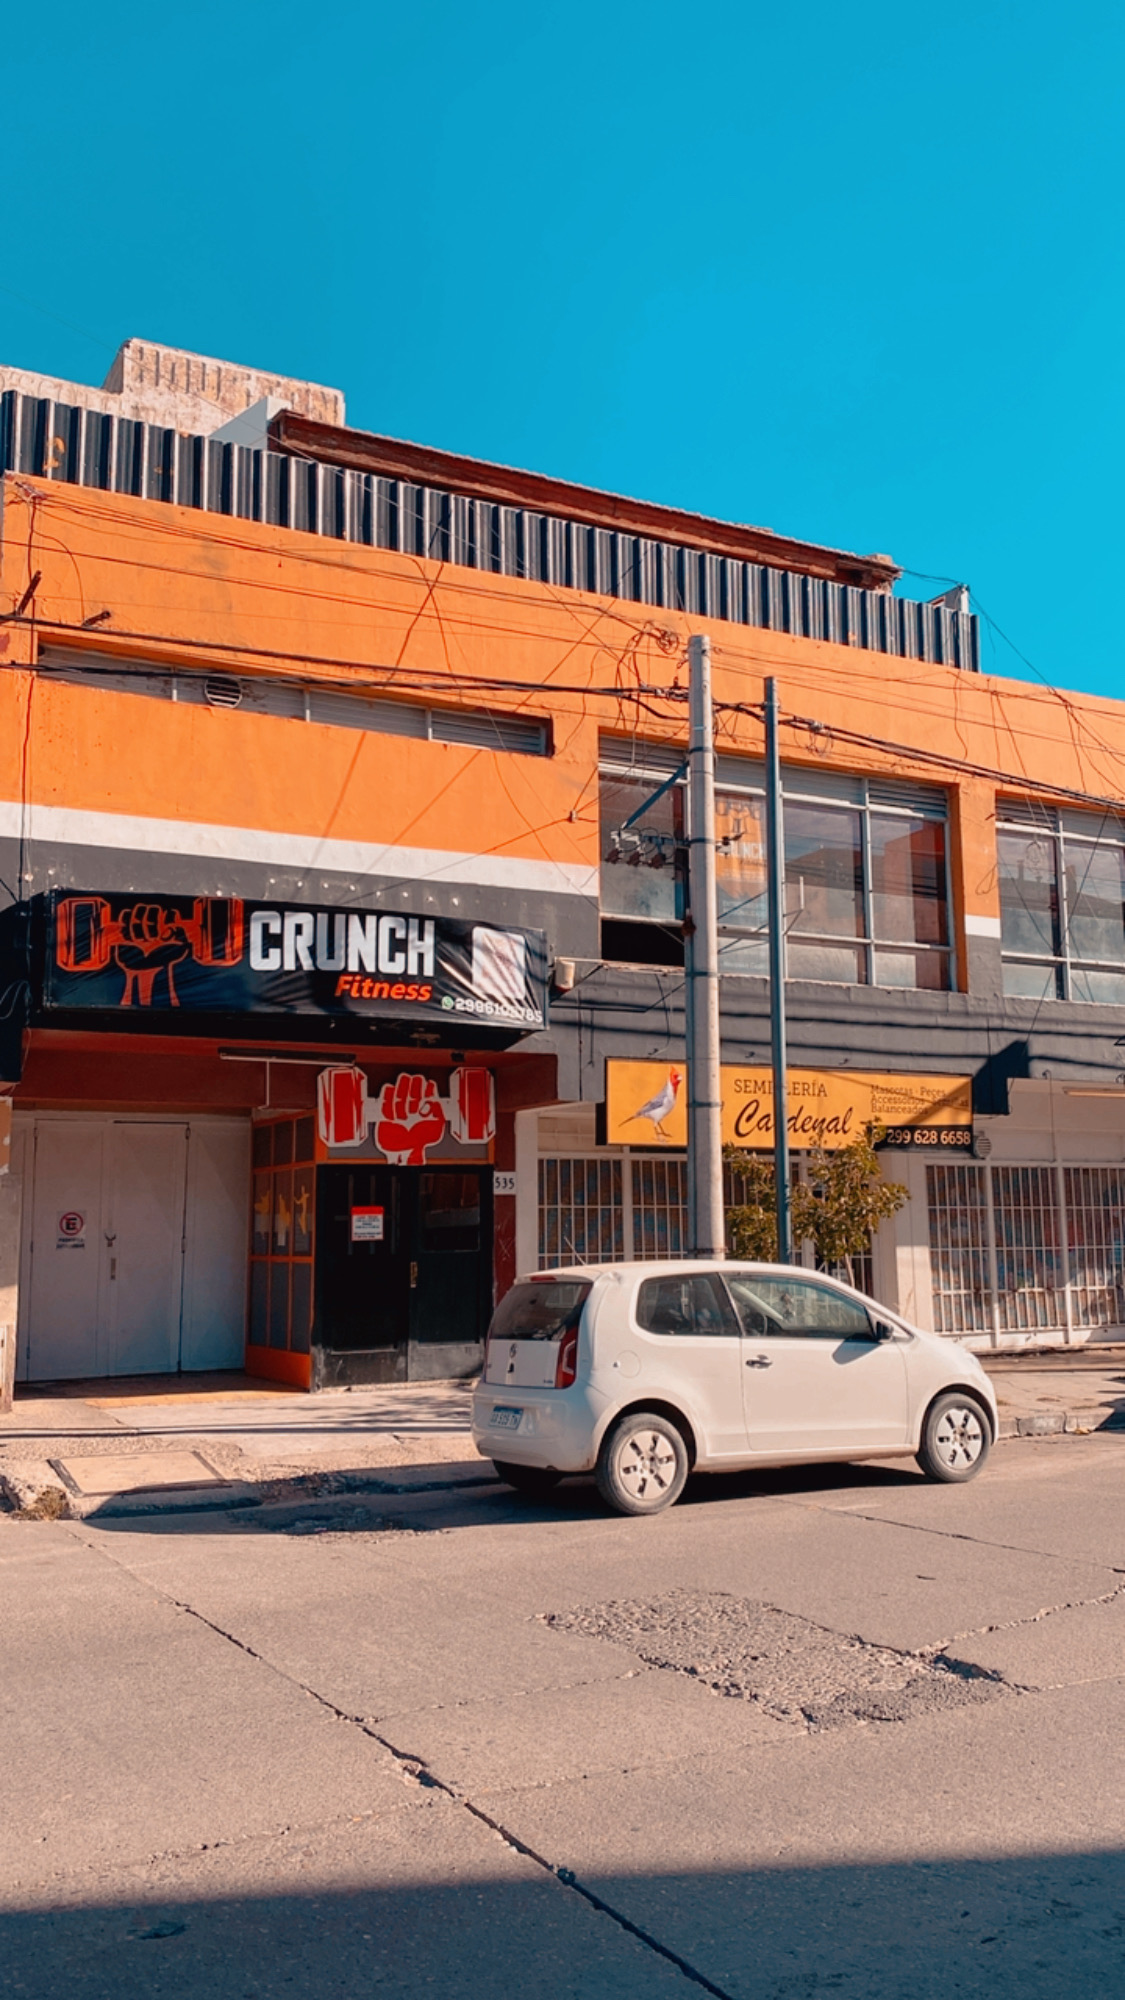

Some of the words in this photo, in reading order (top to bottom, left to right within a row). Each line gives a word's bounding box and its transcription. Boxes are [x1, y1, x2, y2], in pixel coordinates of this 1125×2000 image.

[250, 910, 435, 977] CRUNCH
[334, 974, 432, 1002] Fitness
[734, 1079, 827, 1097] SEMIERÍA
[734, 1099, 853, 1138] Cadenal
[887, 1129, 911, 1144] 299
[913, 1129, 938, 1145] 628
[940, 1130, 971, 1145] 6658
[495, 1176, 515, 1190] 535
